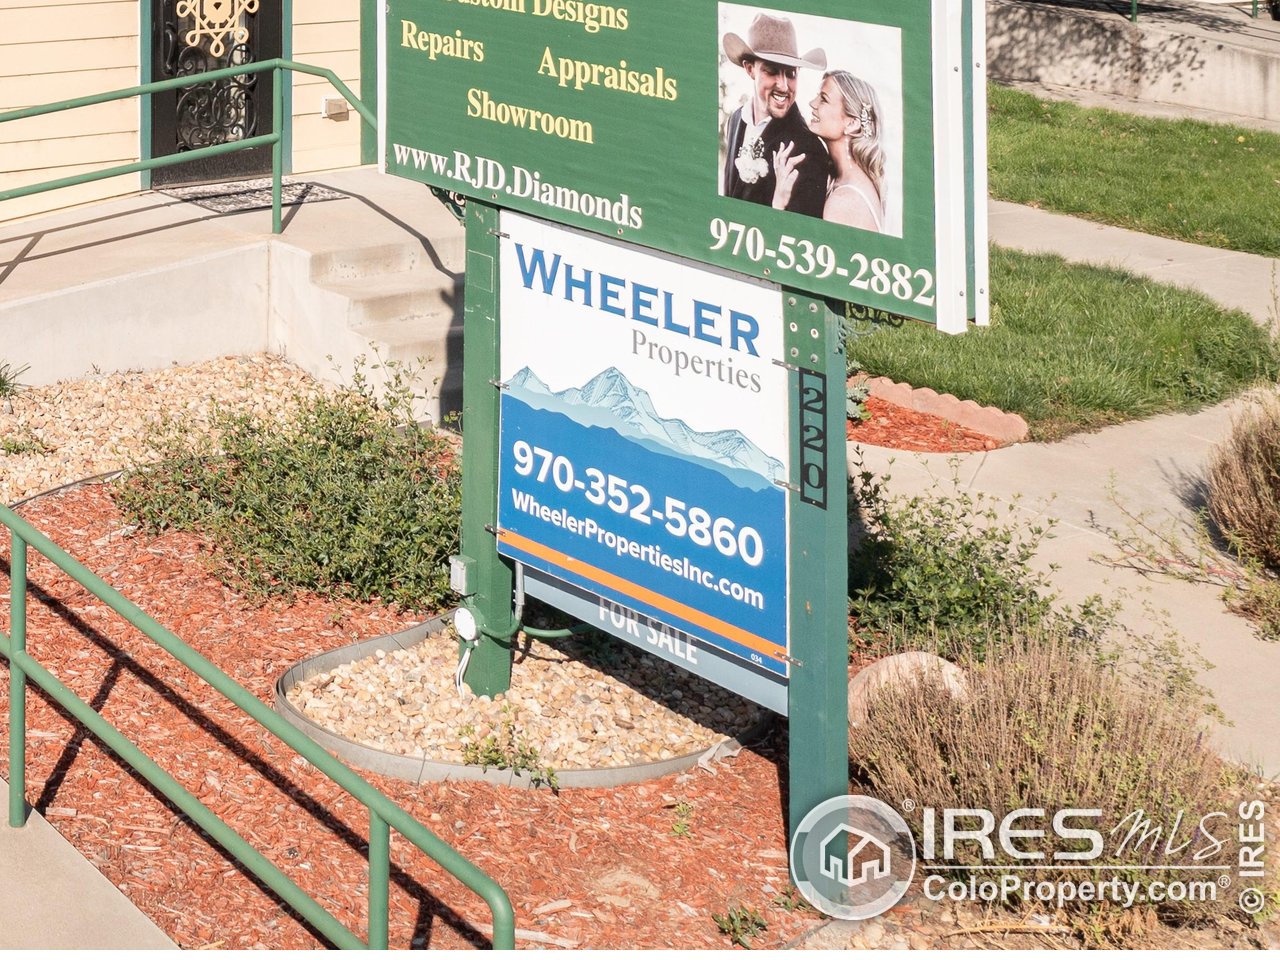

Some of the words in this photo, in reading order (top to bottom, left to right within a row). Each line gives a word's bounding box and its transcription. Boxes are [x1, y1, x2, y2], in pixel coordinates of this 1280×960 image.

[400, 19, 484, 62] Repairs
[537, 46, 678, 101] Appraisals
[467, 88, 594, 145] Showroom
[393, 143, 642, 230] www.RJD.Diamonds
[514, 242, 761, 358] WHEELER
[709, 217, 936, 307] 970-539-2882
[631, 328, 762, 394] Properties
[512, 440, 764, 567] 970-352-5860
[511, 489, 764, 610] WheelerPropertiesInc.com
[598, 597, 640, 639] FOR
[646, 616, 699, 665] SALE
